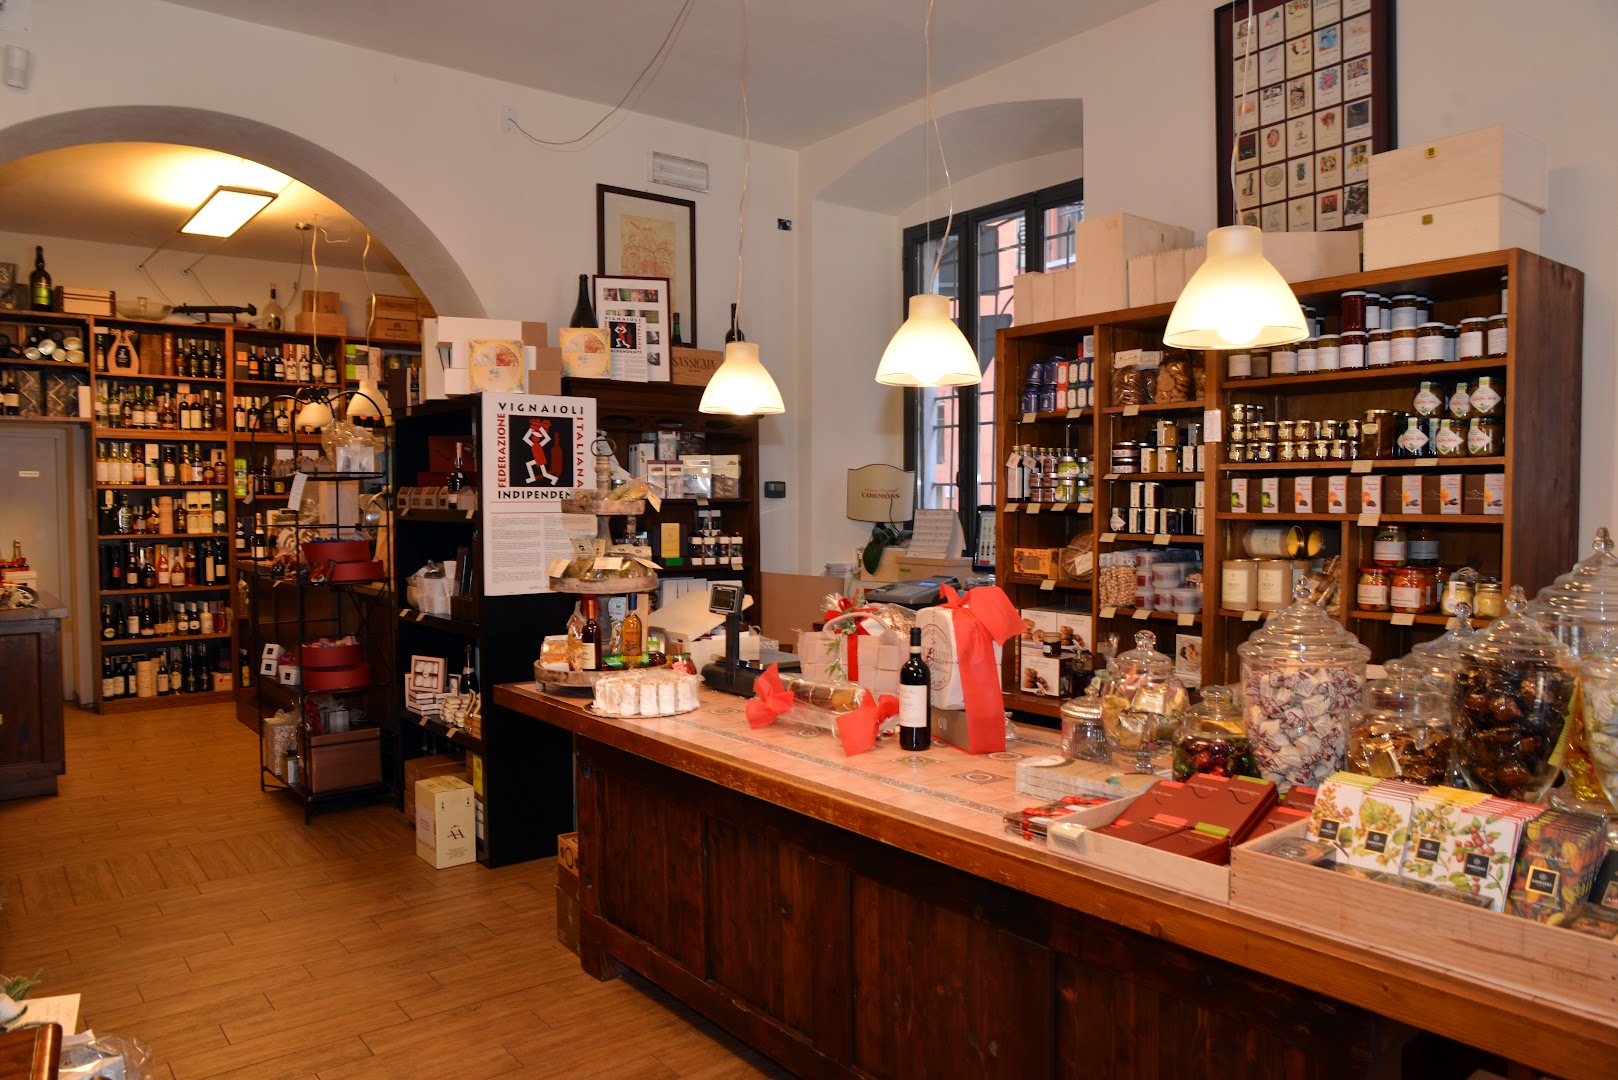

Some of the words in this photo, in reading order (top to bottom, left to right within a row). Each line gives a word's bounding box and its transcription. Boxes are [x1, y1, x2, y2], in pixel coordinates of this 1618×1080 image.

[498, 402, 584, 415] VIGNAIOLI
[497, 413, 507, 488] FEDERAZIONE
[576, 417, 585, 488] ITALIANA
